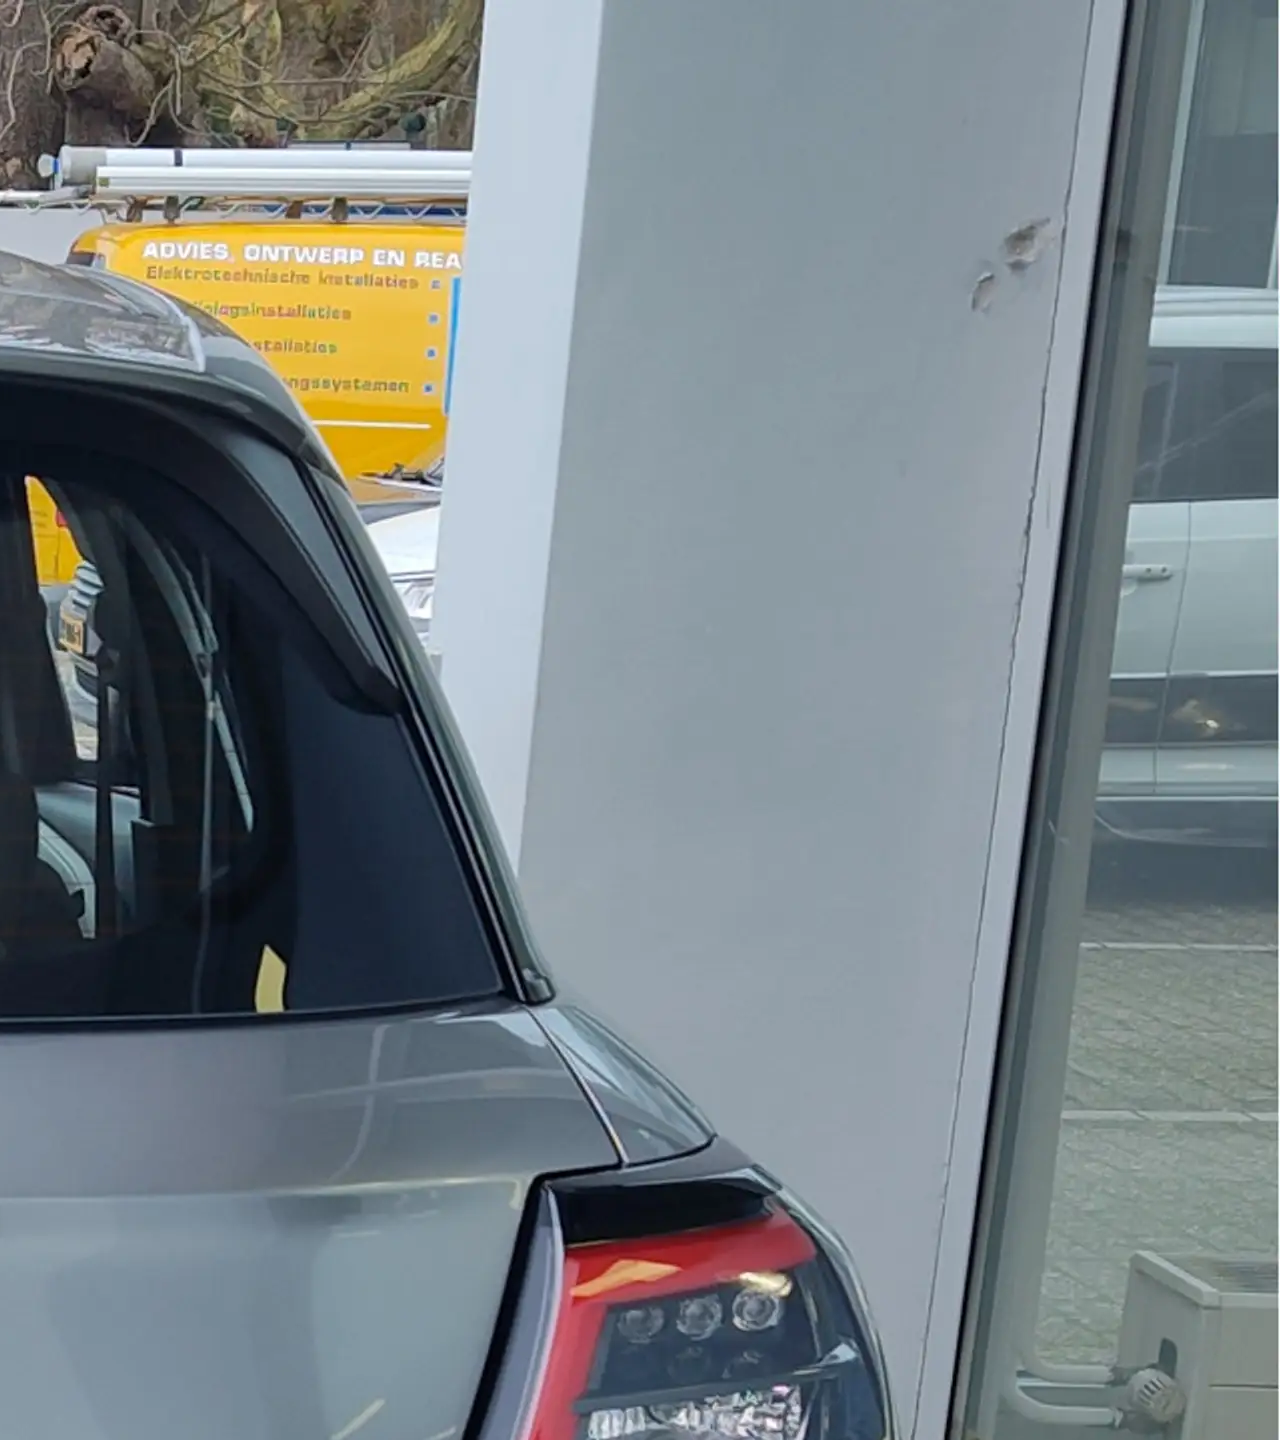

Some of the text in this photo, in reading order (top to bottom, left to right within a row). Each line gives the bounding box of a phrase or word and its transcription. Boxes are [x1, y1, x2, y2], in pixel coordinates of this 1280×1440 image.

[243, 243, 364, 265] ONTWERP
[372, 249, 405, 267] EN
[146, 264, 311, 285] Elektrotechnische
